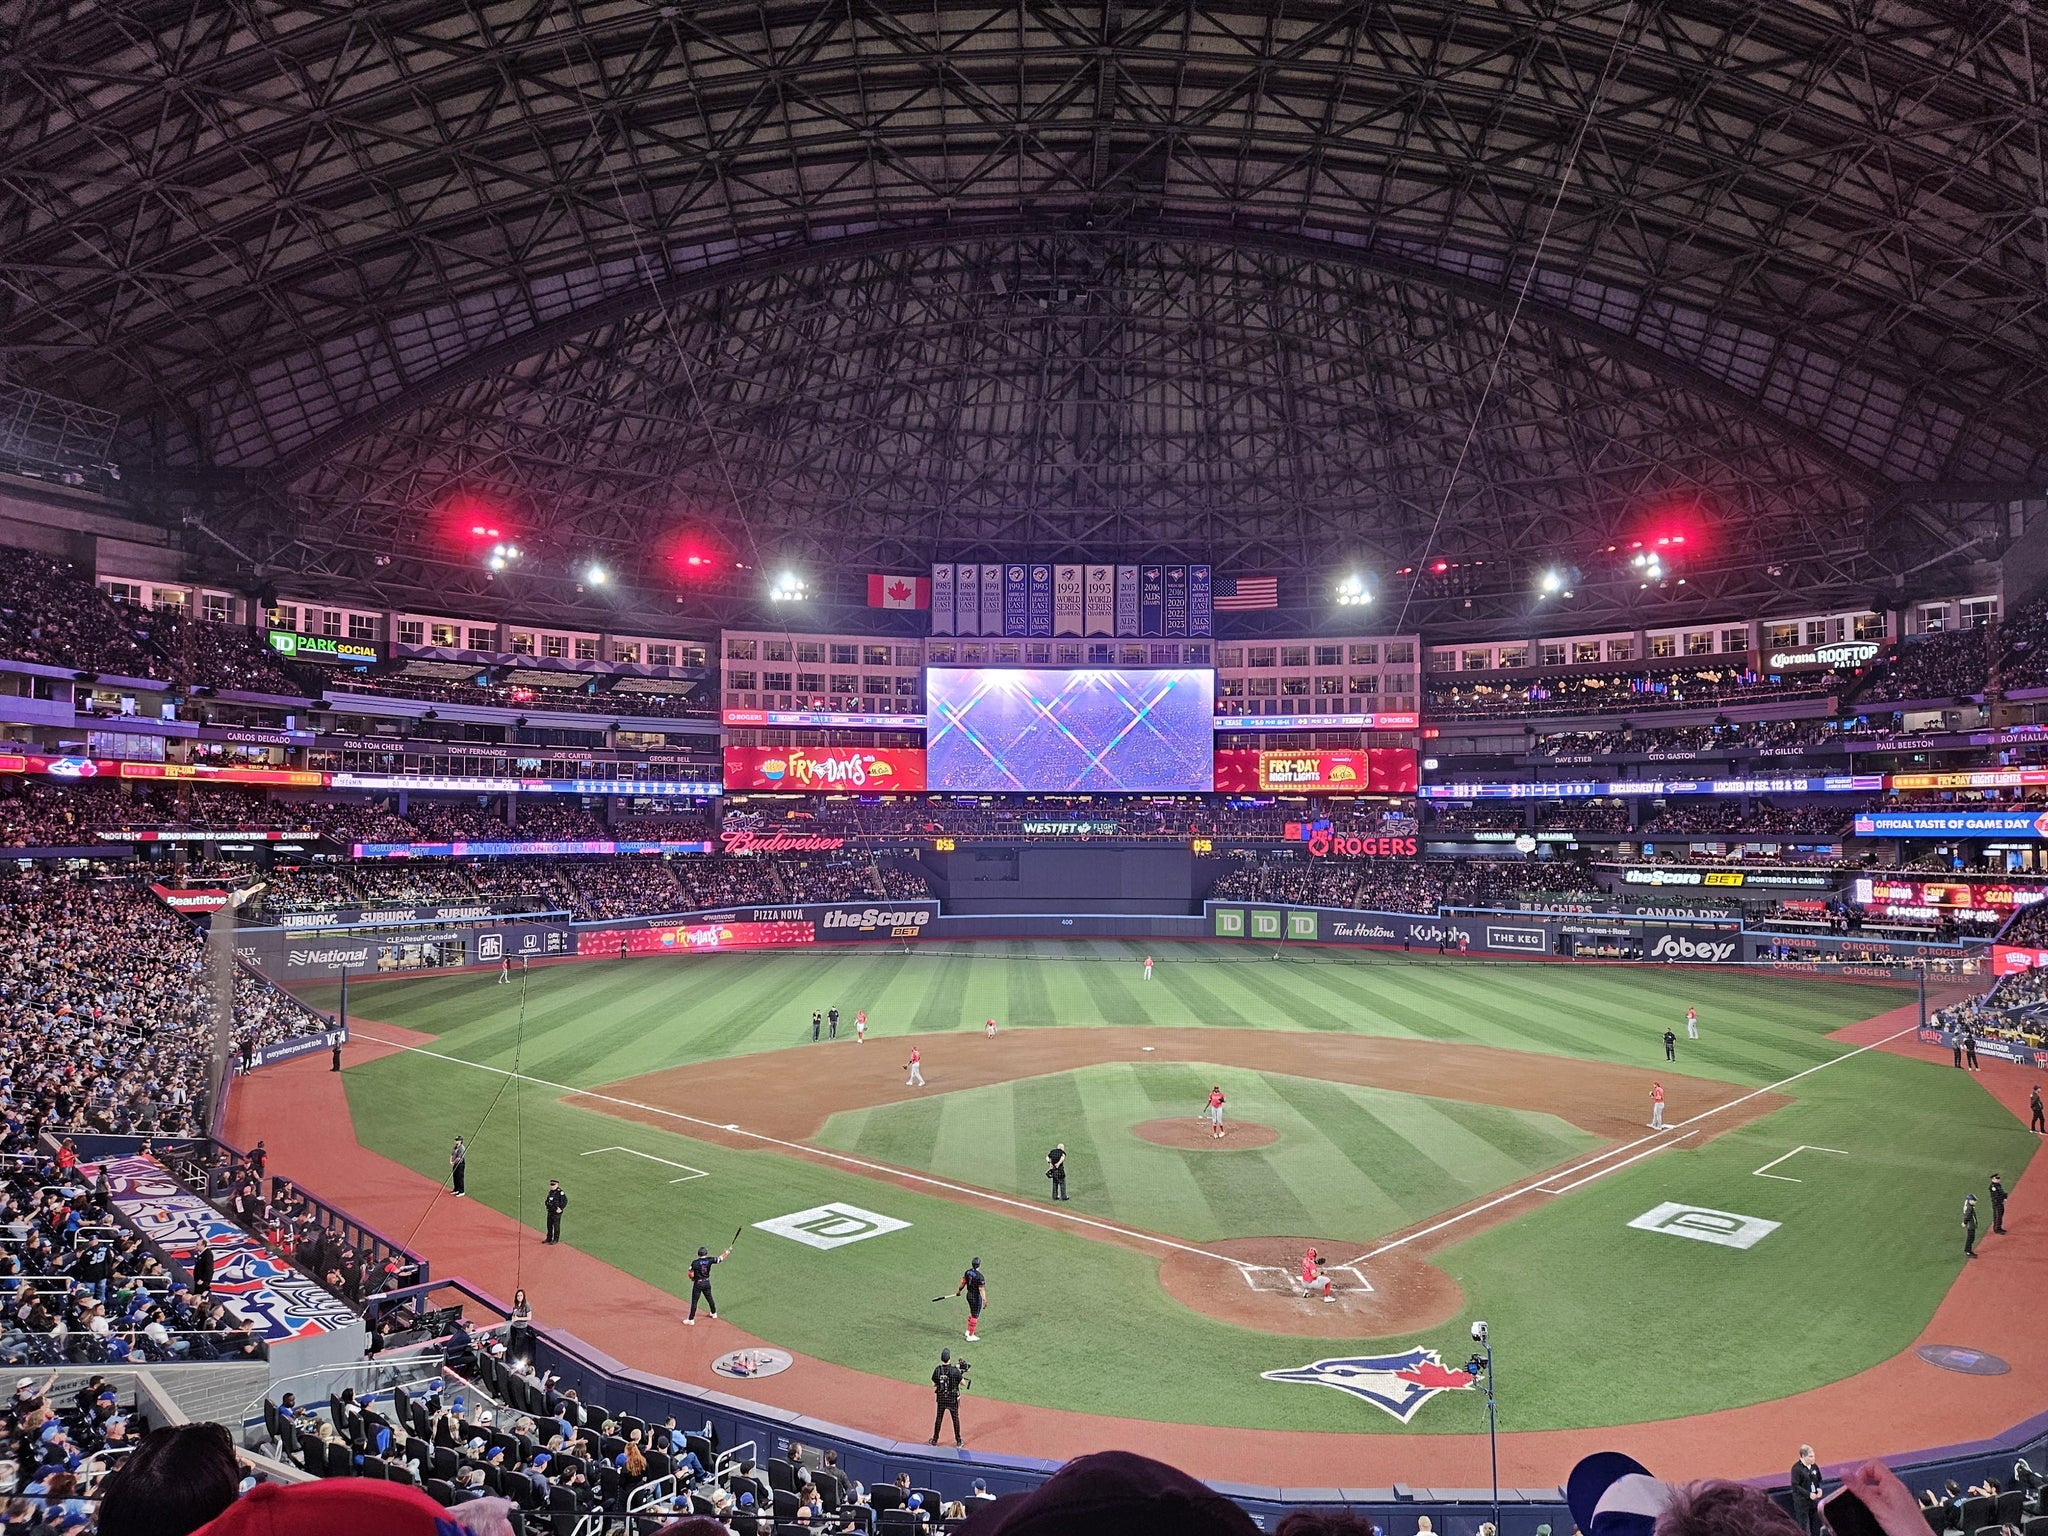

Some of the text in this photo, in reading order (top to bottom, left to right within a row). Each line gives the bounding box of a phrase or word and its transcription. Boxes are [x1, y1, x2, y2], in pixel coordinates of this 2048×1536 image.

[1058, 584, 1080, 594] 1992
[1089, 584, 1111, 594] 1993
[272, 636, 376, 656] TD PARK SOCIAL
[1770, 646, 1878, 668] Corona ROOFTOP
[1834, 660, 1861, 668] PATIO
[227, 732, 290, 744] CARLOS DELGADO
[2001, 735, 2018, 743] ROY
[344, 740, 404, 751] 4306 TOM CHEEK
[1898, 740, 1934, 749] BEESTON
[447, 747, 507, 756] TONY FERNANDEZ
[568, 752, 592, 760] CARTER
[789, 752, 866, 786] FRY DAYS
[1269, 760, 1320, 773] FRY-DAY
[1269, 772, 1320, 781] NIGHT LIGHTS
[1937, 774, 2021, 785] FRY-DAY NIGHT LIGHTS
[1610, 783, 1664, 793] EXCLUSIVELY AT
[1714, 781, 1744, 791] LOCATED
[1755, 781, 1770, 791] SEC.
[1771, 781, 1784, 790] 112
[1785, 780, 1792, 790] &
[1793, 780, 1808, 790] 123
[1023, 823, 1077, 836] WESTJET
[1876, 820, 2030, 828] OFFICIAL TASTE OF GAME DAY
[158, 832, 181, 840] PROUD
[182, 832, 205, 840] OWNER
[206, 832, 214, 840] OF
[216, 832, 249, 840] CANADA'S
[250, 832, 267, 840] TEAM
[720, 831, 844, 852] Budweiser
[1474, 832, 1500, 840] CANADA
[1501, 832, 1516, 840] DRY
[1333, 838, 1418, 855] ROGERS
[1626, 871, 1701, 884] theScore
[1707, 875, 1742, 883] BET
[1874, 887, 1889, 897] SCAN
[1985, 891, 2012, 903] SCAN
[167, 895, 226, 906] BeautiTone
[358, 909, 416, 923] SUBWAY
[435, 907, 491, 919] SUBWAY
[753, 909, 803, 921] PIZZA NOVA
[823, 909, 929, 928] theScore
[1636, 907, 1695, 918] CANADA
[281, 913, 338, 927] SUBWAY
[1218, 914, 1241, 931] TD
[1254, 916, 1277, 932] TD
[1291, 917, 1314, 933] TD
[1333, 923, 1395, 938] Tim Hortons
[1410, 925, 1470, 943] Kubota
[1562, 925, 1584, 933] Active
[1494, 933, 1539, 944] THE KEG
[1783, 938, 1817, 947] ROGERS
[1651, 935, 1736, 961] Sobeys
[1852, 943, 1890, 951] ROGERS
[1930, 948, 1969, 957] ROGERS
[307, 947, 366, 964] National
[2005, 952, 2032, 965] HEINZ
[1783, 963, 1817, 972] ROGERS
[1854, 968, 1891, 977] ROGERS
[1930, 974, 1970, 983] ROGERS
[325, 1031, 346, 1046] VIA
[1920, 1030, 1943, 1042] HEINZ
[267, 1048, 293, 1058] everywhere
[792, 1209, 878, 1238] TD
[1654, 1211, 1747, 1235] TD
[90, 1252, 106, 1264] 39
